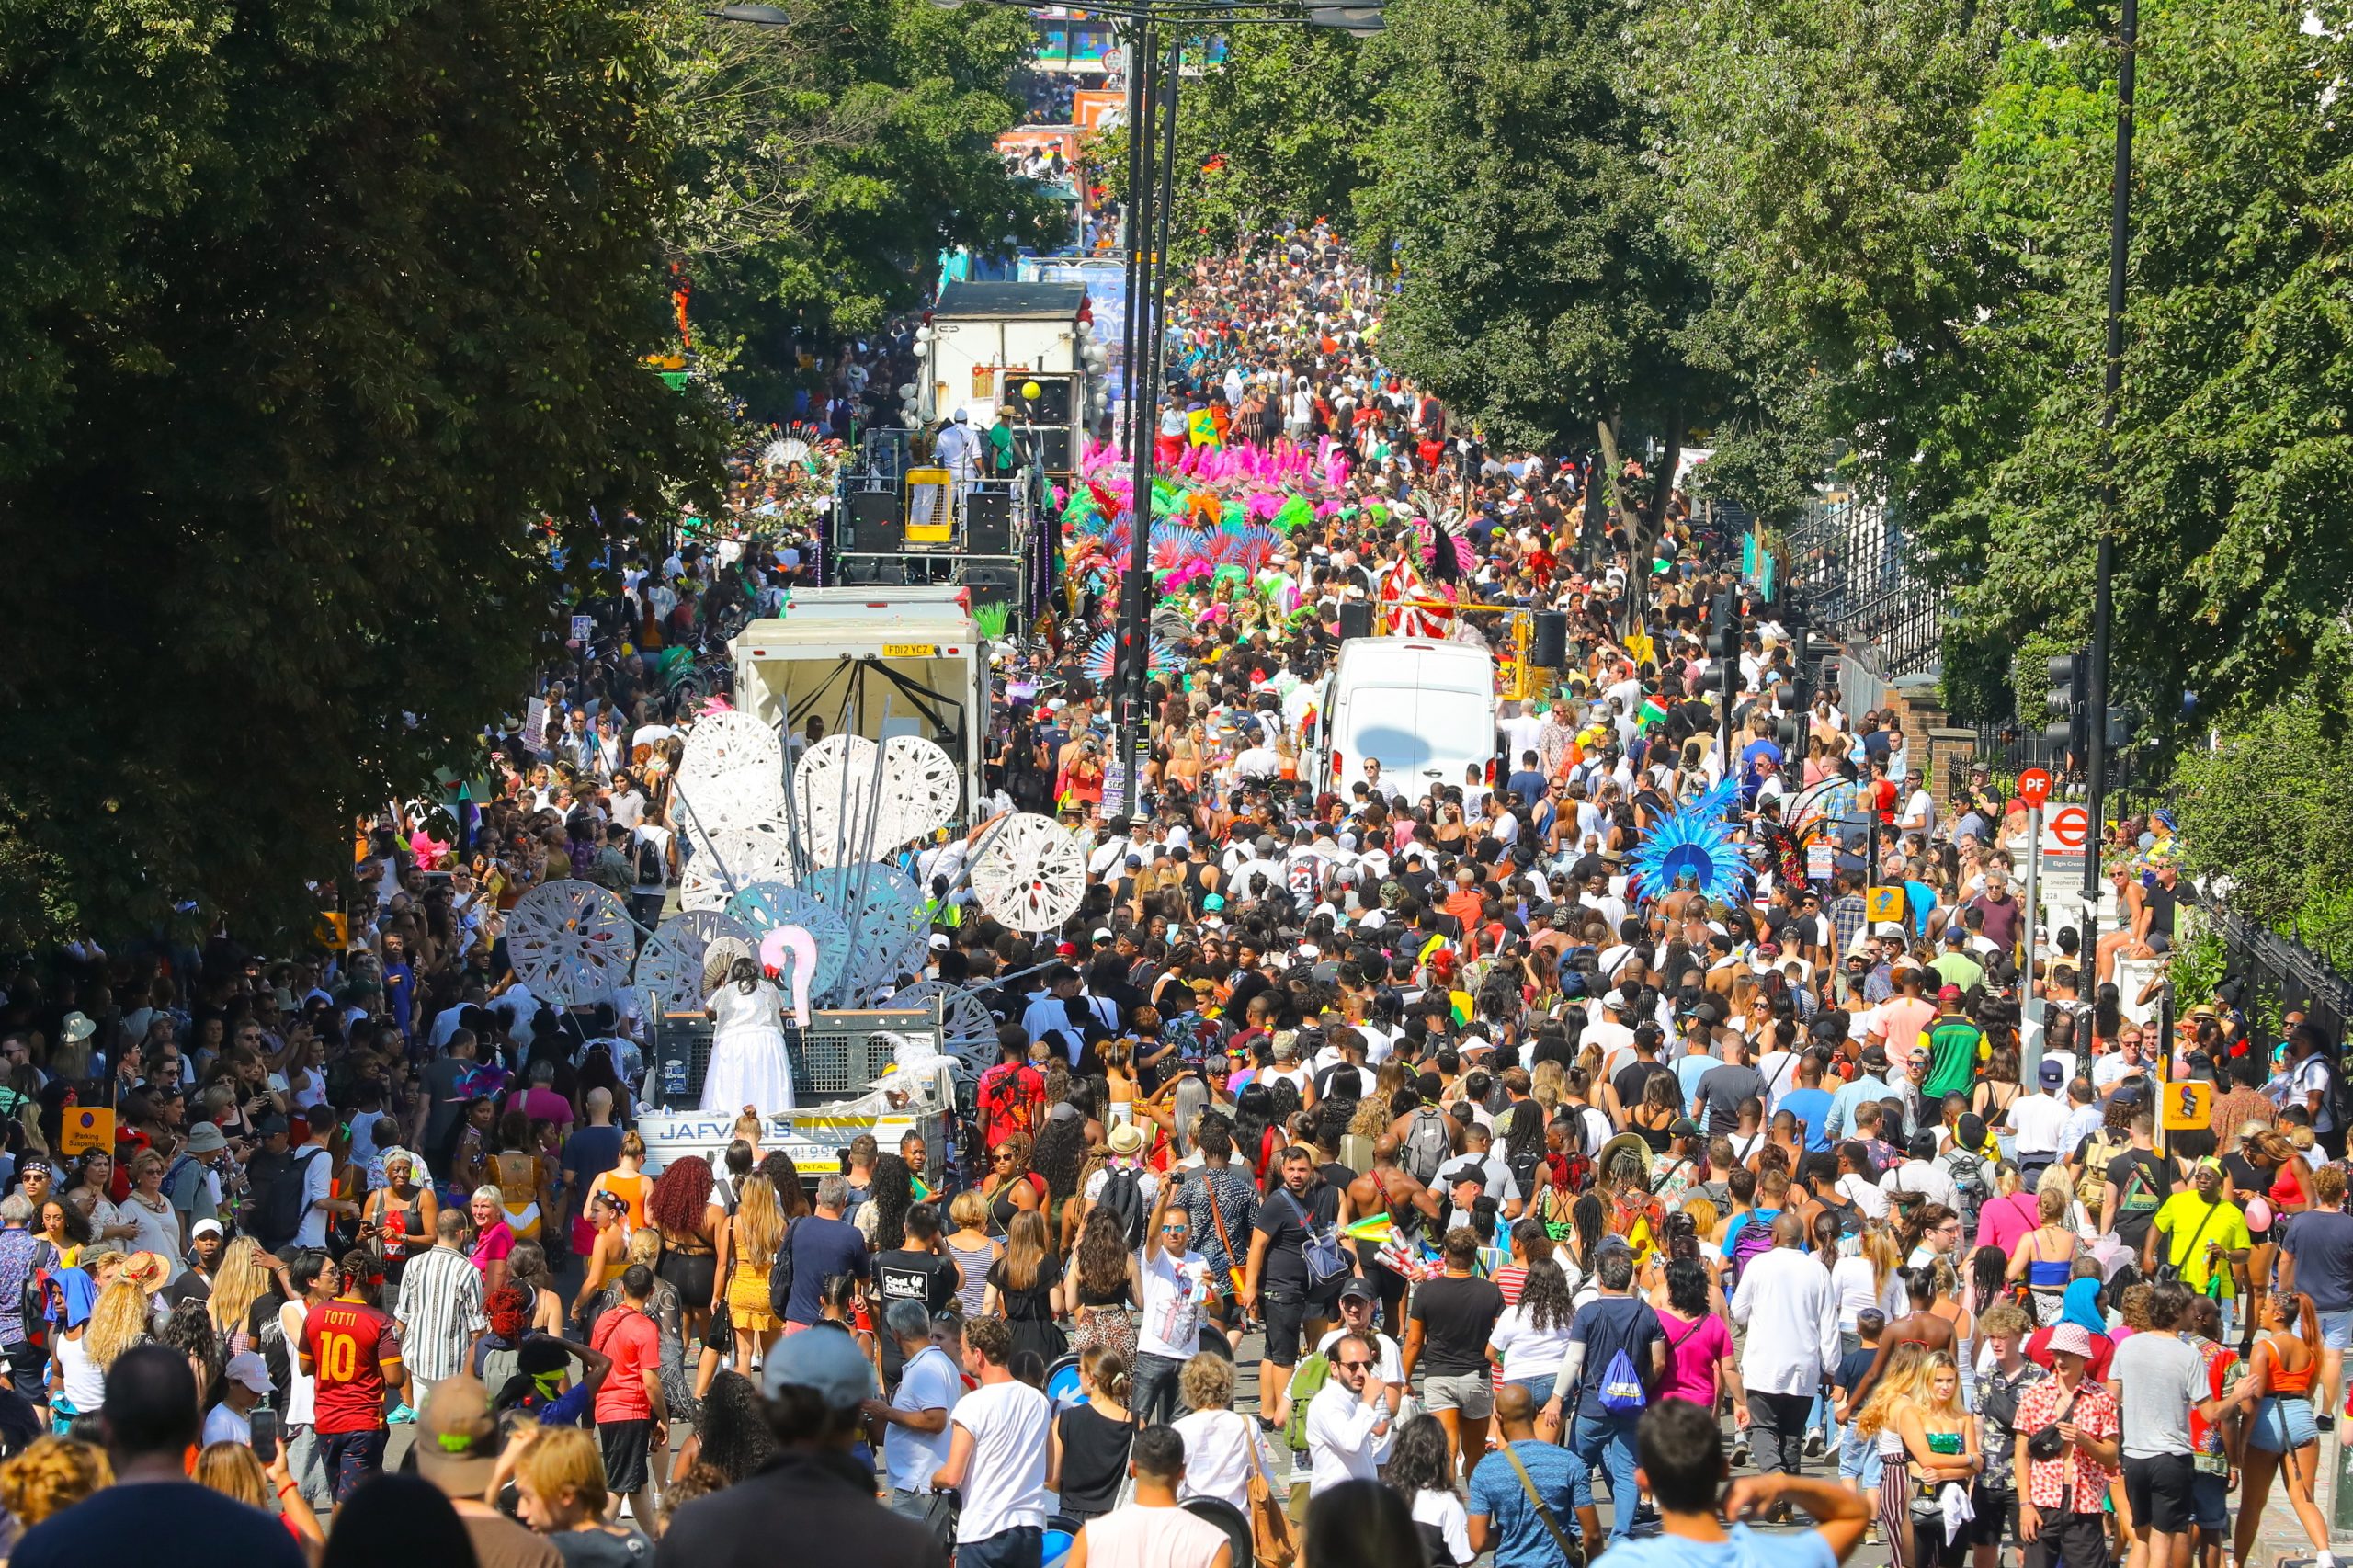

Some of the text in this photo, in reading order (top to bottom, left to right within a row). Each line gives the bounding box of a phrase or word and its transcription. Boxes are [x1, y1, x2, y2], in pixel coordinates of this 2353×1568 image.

[889, 645, 928, 654] FD12 YCZ
[2026, 778, 2045, 792] PF
[1288, 872, 1313, 892] 23
[75, 1132, 99, 1142] Parking
[69, 1140, 105, 1148] Suspension
[885, 1275, 910, 1287] Cool
[324, 1310, 357, 1327] TOTTI
[320, 1330, 356, 1382] 10
